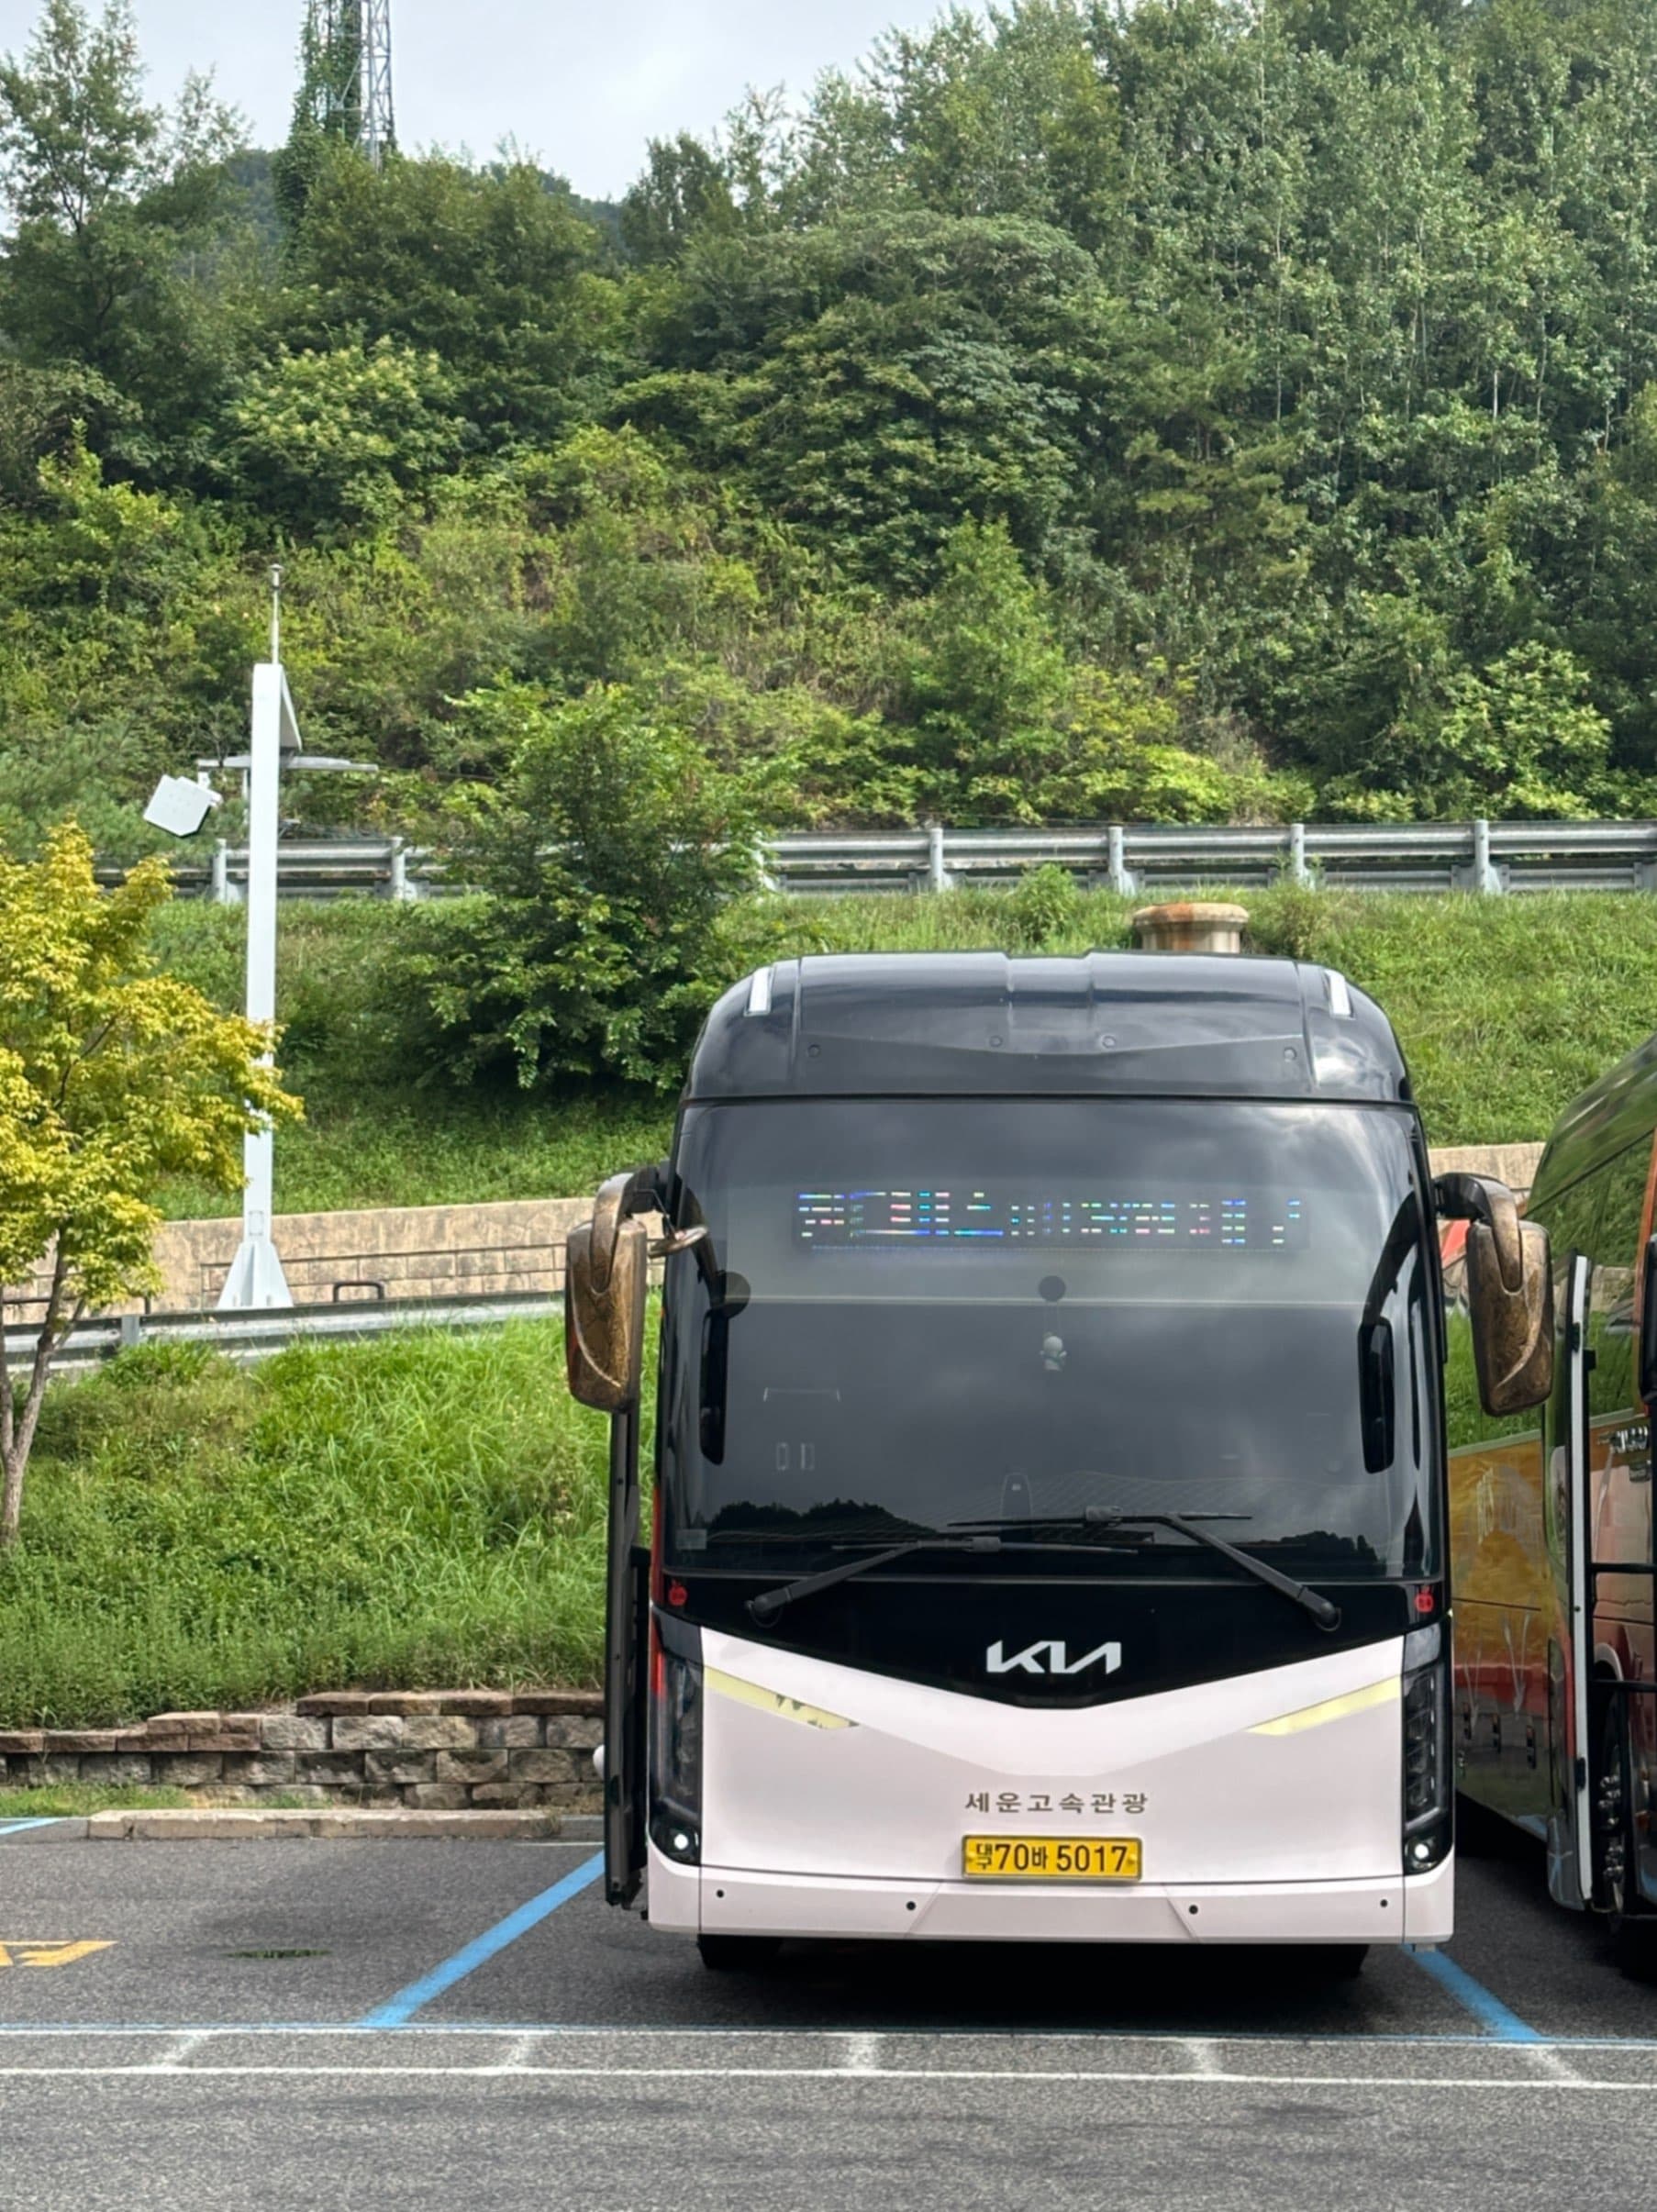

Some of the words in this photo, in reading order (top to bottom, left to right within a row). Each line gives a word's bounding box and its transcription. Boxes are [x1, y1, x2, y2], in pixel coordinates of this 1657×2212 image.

[986, 1640, 1122, 1674] KIA
[965, 1792, 1148, 1814] 세운고속관광
[1056, 1844, 1128, 1873] 5017
